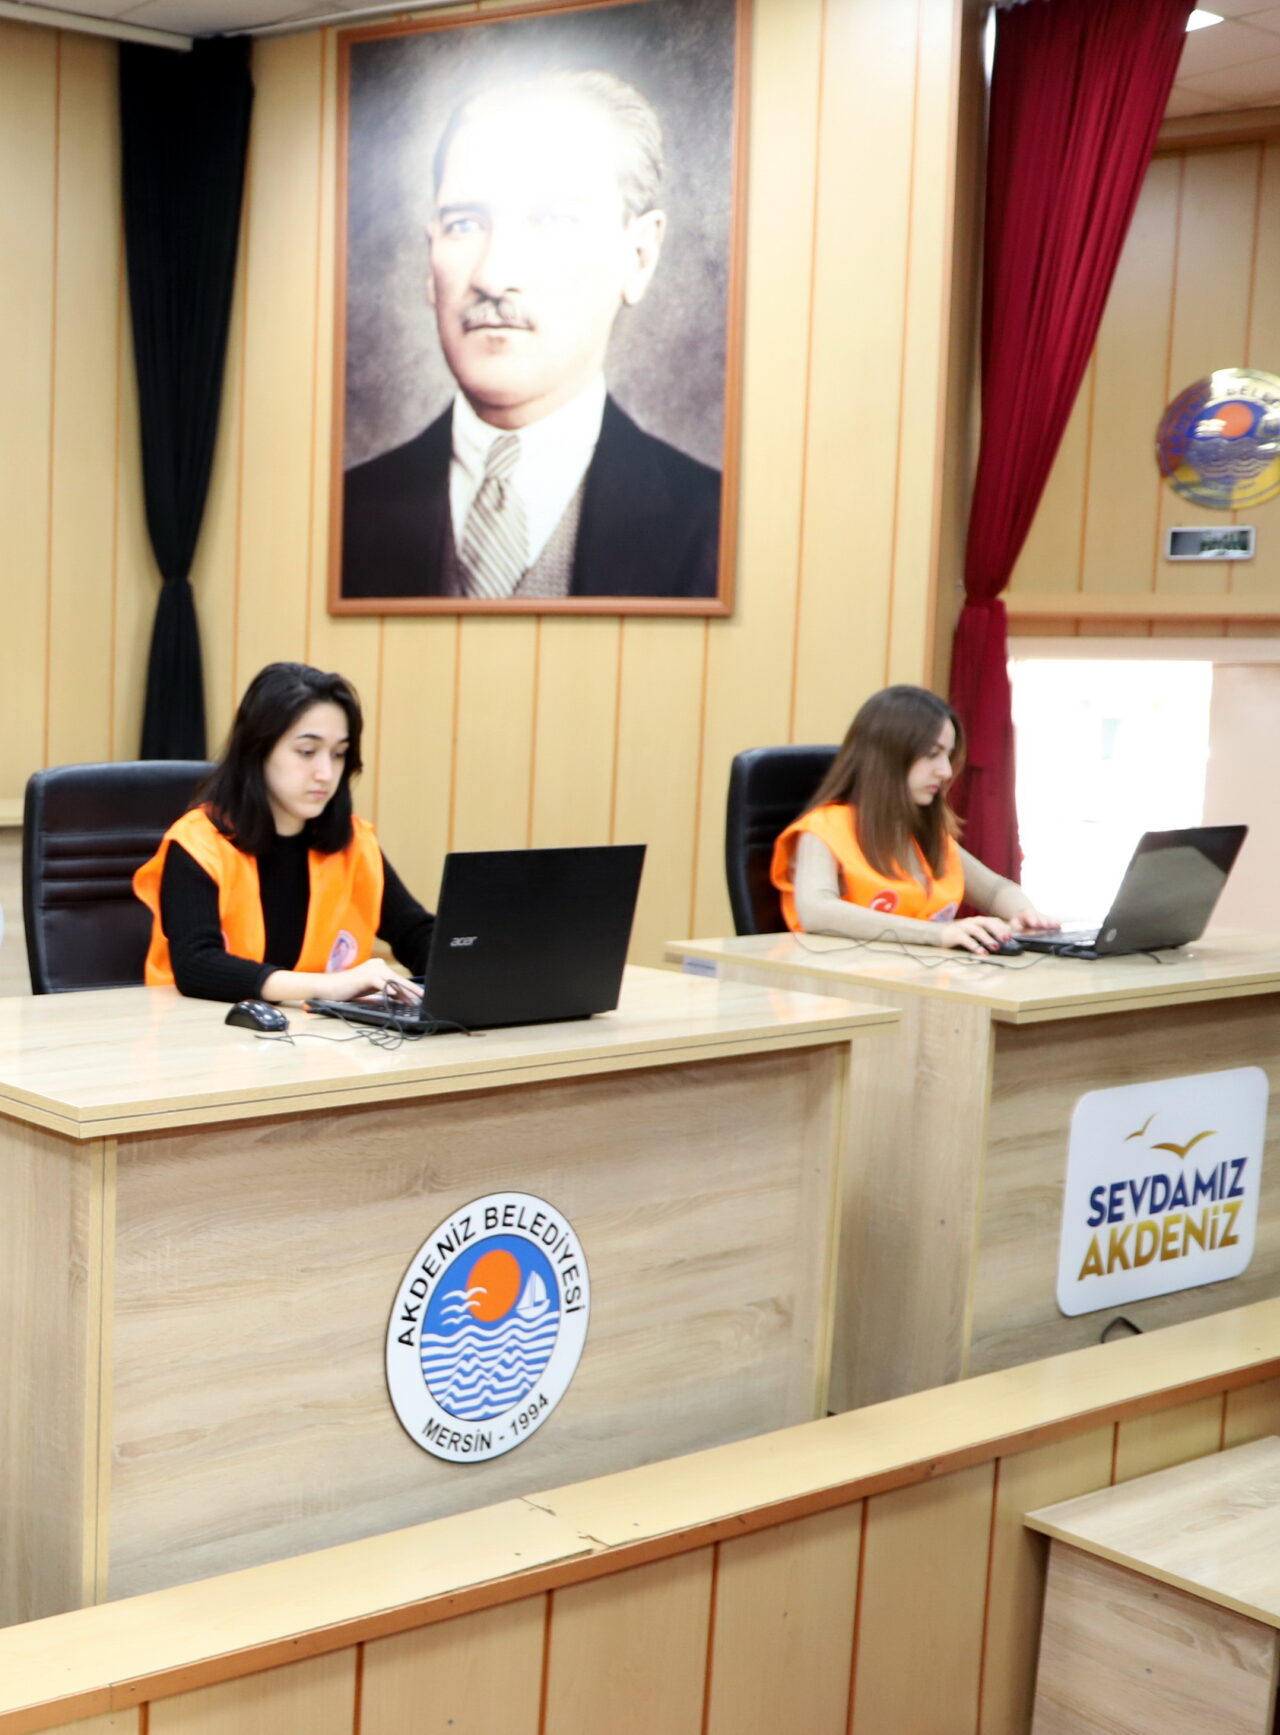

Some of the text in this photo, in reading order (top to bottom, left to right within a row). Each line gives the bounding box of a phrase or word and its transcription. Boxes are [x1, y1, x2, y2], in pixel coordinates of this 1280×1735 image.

[450, 936, 478, 947] acer
[1086, 1157, 1248, 1227] SEVDAMIZ
[398, 1205, 586, 1346] AKDENİZ BELEDİYESİ
[422, 1417, 492, 1453] MERSİN
[509, 1393, 549, 1437] 1994
